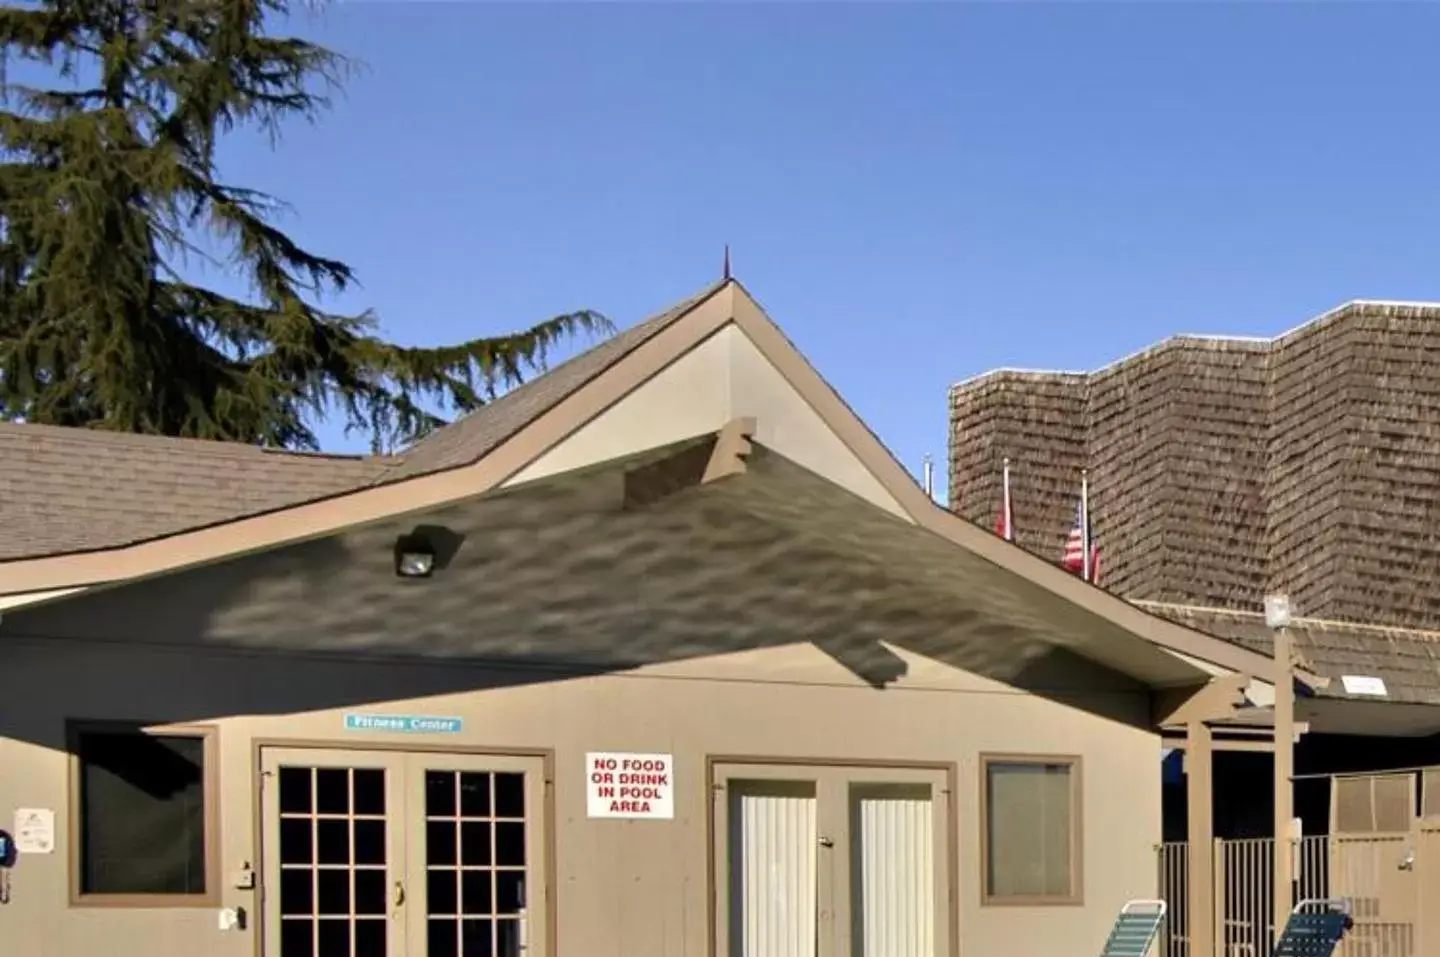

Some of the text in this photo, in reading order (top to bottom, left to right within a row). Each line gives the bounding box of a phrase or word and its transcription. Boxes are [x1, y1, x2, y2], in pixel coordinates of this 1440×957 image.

[354, 715, 453, 731] Fitness Center
[594, 758, 665, 771] NO FOOD
[591, 772, 668, 785] OR DRINK
[598, 786, 662, 799] IN POOL
[610, 800, 651, 812] AREA
